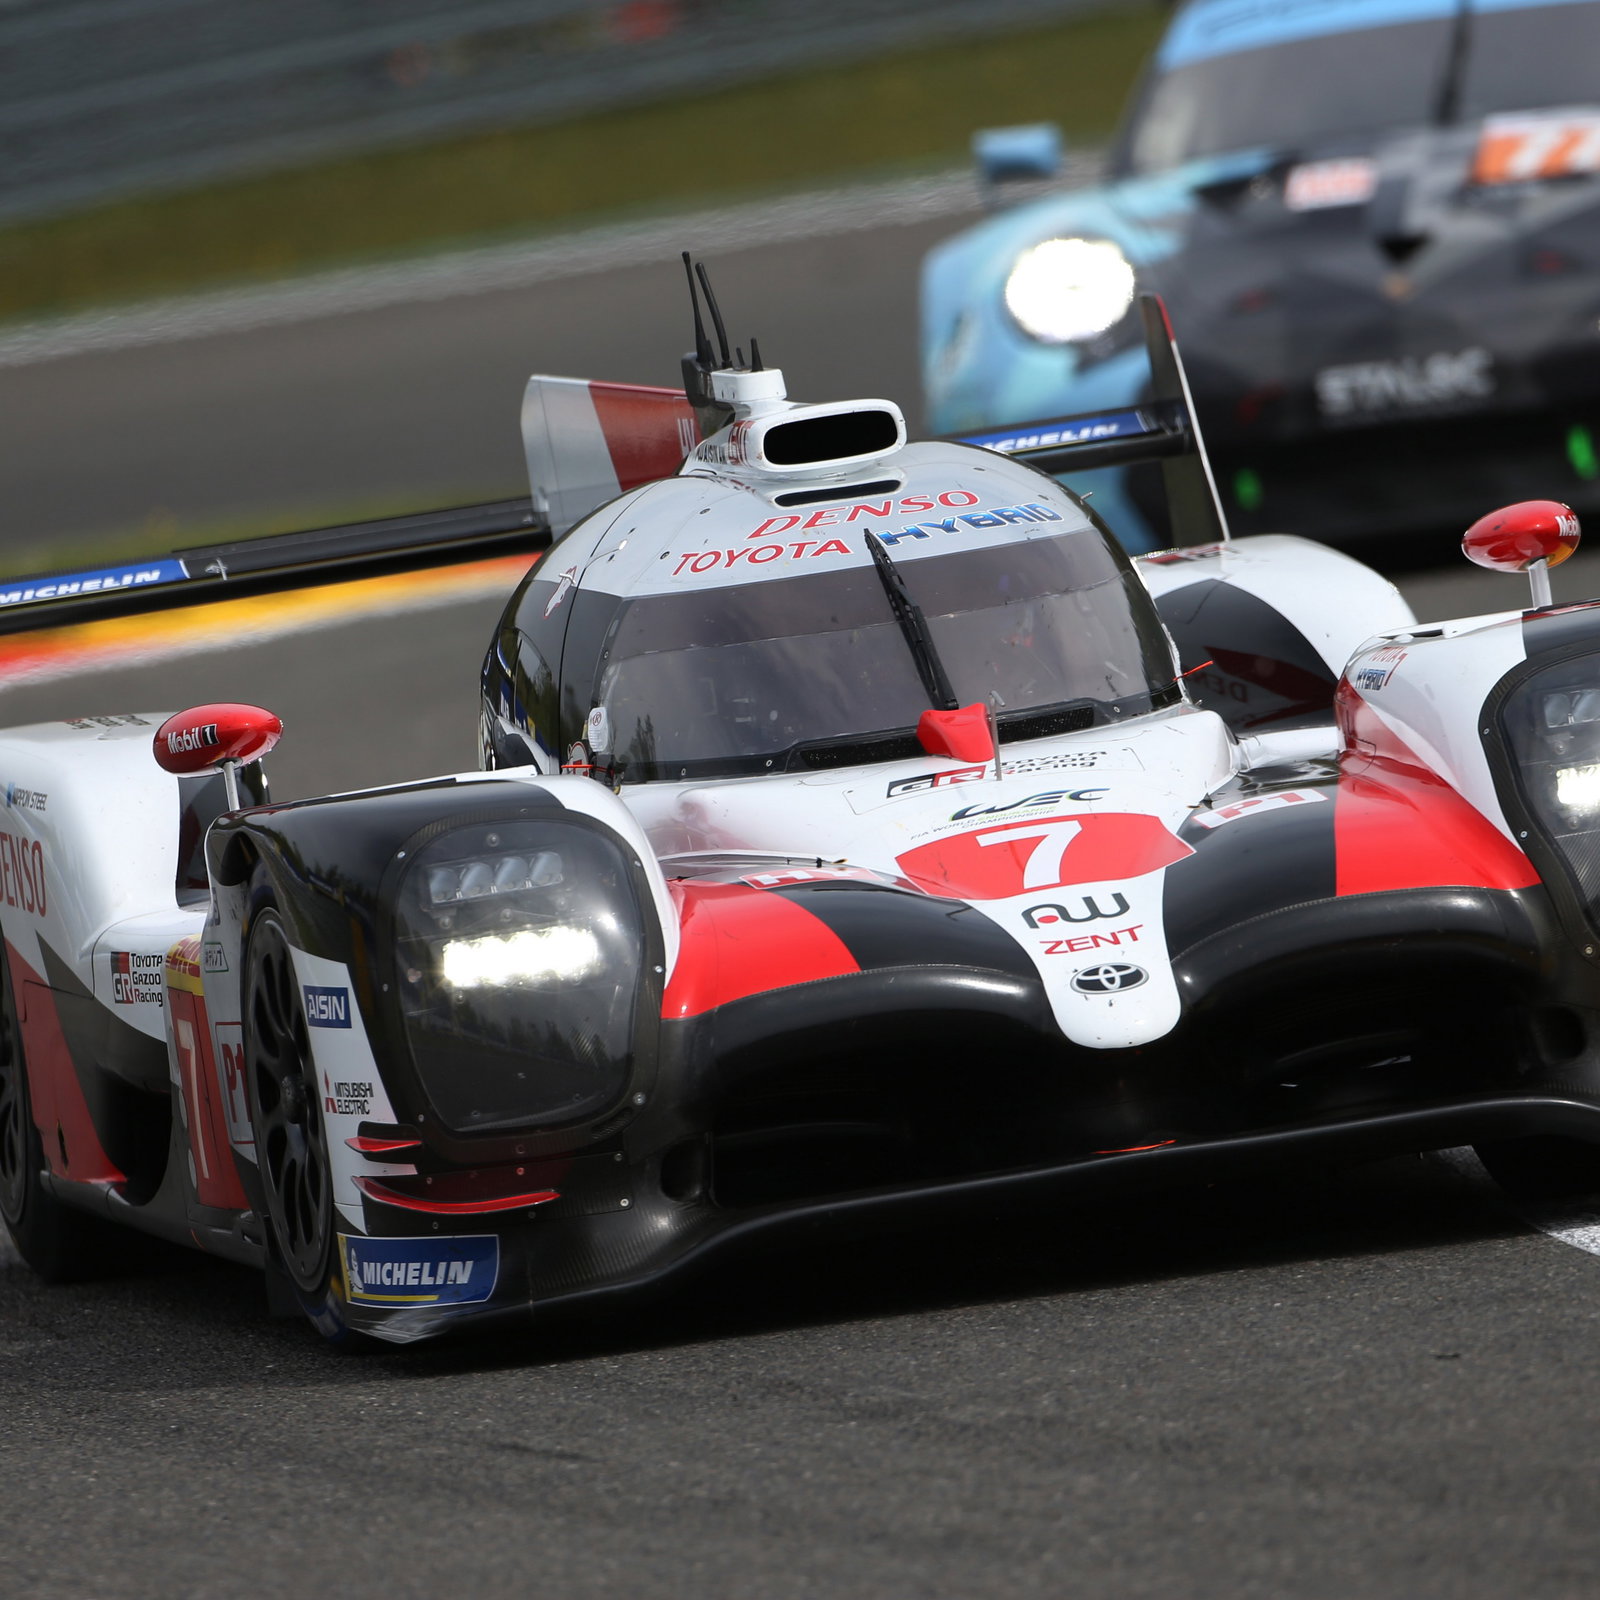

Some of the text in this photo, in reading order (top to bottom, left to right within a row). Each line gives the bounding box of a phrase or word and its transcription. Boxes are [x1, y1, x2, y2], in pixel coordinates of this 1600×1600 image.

[984, 424, 1119, 450] CHELIN
[746, 490, 980, 540] DENSO
[671, 502, 1064, 577] TOYOTA HYBRID
[167, 726, 202, 754] Mobil
[1000, 751, 1107, 766] TOYOTA
[889, 769, 985, 798] GR
[30, 791, 48, 811] STEEL
[910, 806, 1057, 840] FIA WORLD ENDURANCE
[961, 810, 1055, 829] CHAMPIONSHIP
[976, 819, 1083, 889] 7
[1039, 924, 1144, 955] ZENT
[131, 953, 163, 968] TOYOTA
[133, 988, 163, 1007] Racing
[308, 994, 346, 1021] AISIN
[177, 1019, 209, 1179] 7
[334, 1082, 375, 1098] MITSUBISHI
[336, 1099, 371, 1115] ELECTRIC
[362, 1260, 474, 1286] MICHELIN
